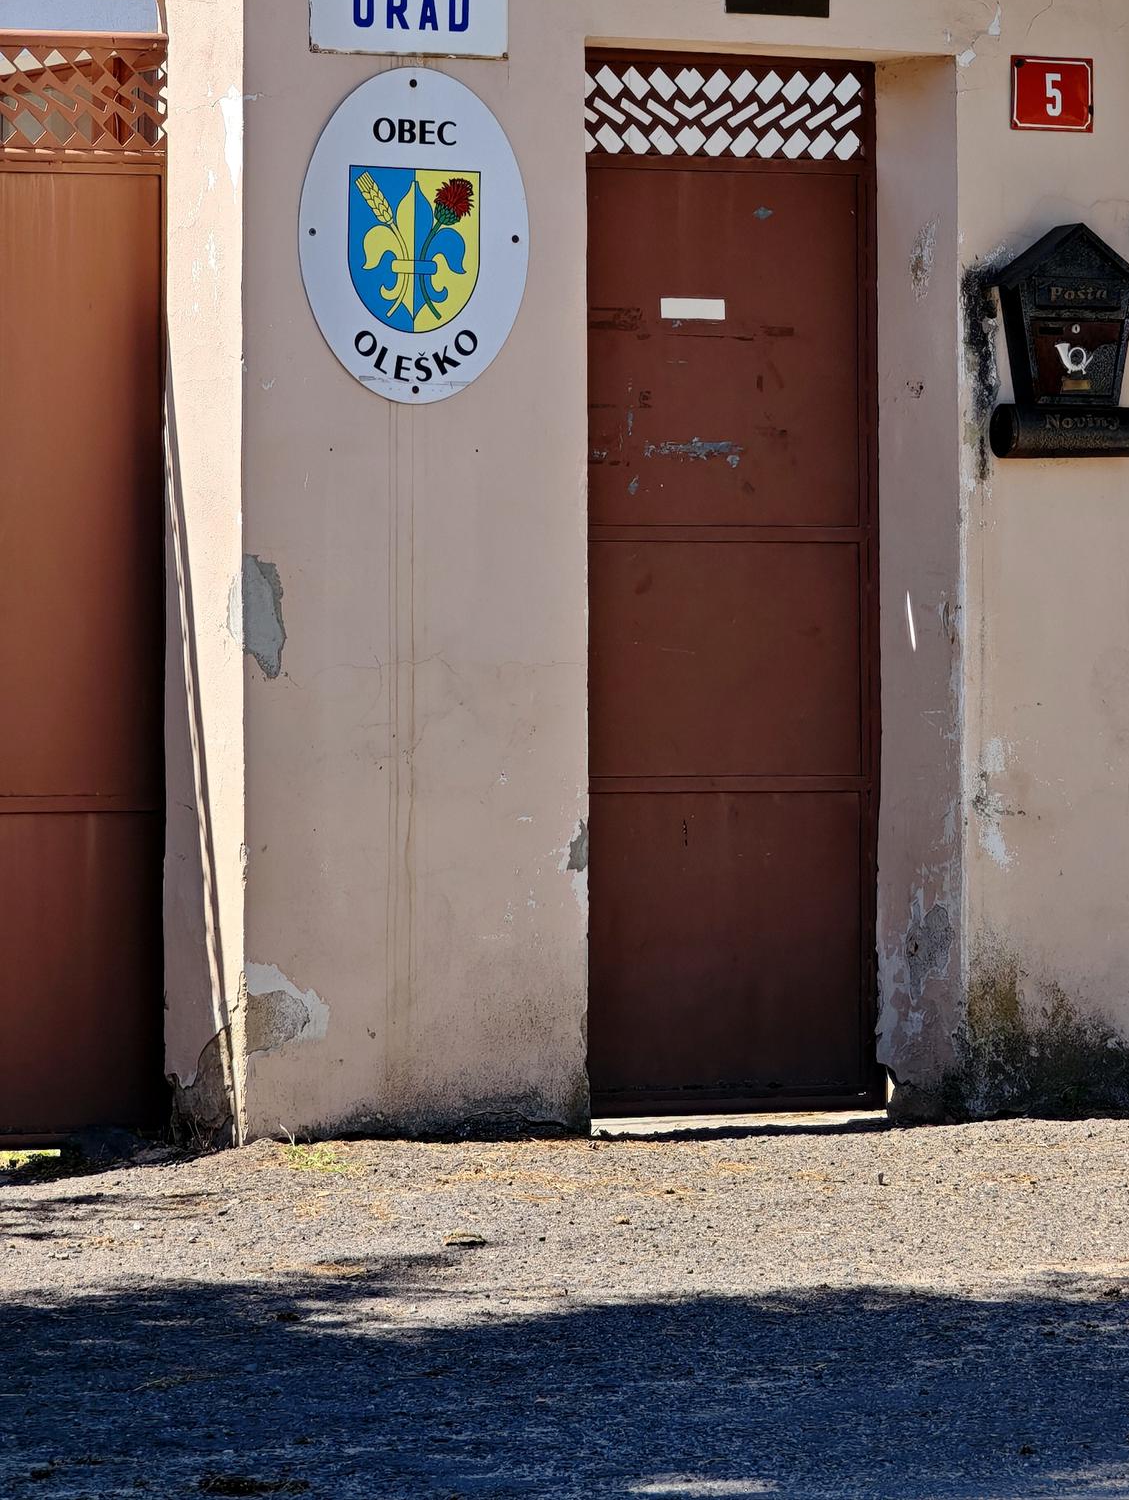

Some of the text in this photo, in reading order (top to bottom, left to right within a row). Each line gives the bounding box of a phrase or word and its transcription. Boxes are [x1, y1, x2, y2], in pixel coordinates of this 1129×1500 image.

[1045, 72, 1063, 117] 5
[372, 116, 458, 147] OBEC
[1049, 283, 1108, 302] Pošta
[353, 329, 479, 383] OLEŠKO
